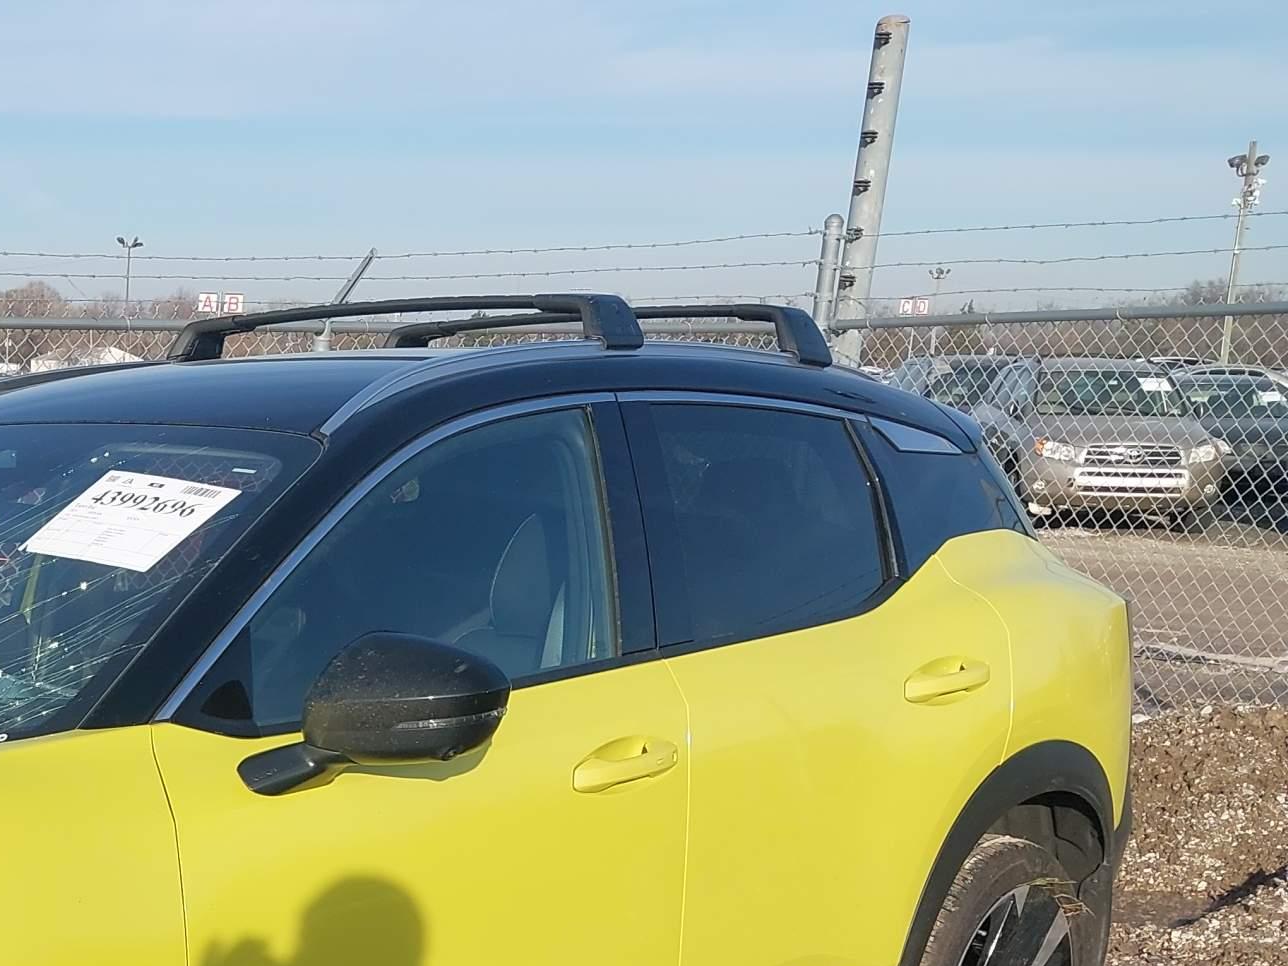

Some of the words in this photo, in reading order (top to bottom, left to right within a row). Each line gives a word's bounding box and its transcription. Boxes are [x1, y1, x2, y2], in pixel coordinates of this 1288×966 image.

[202, 296, 212, 312] A
[228, 297, 239, 312] B
[91, 489, 203, 517] 43992696
